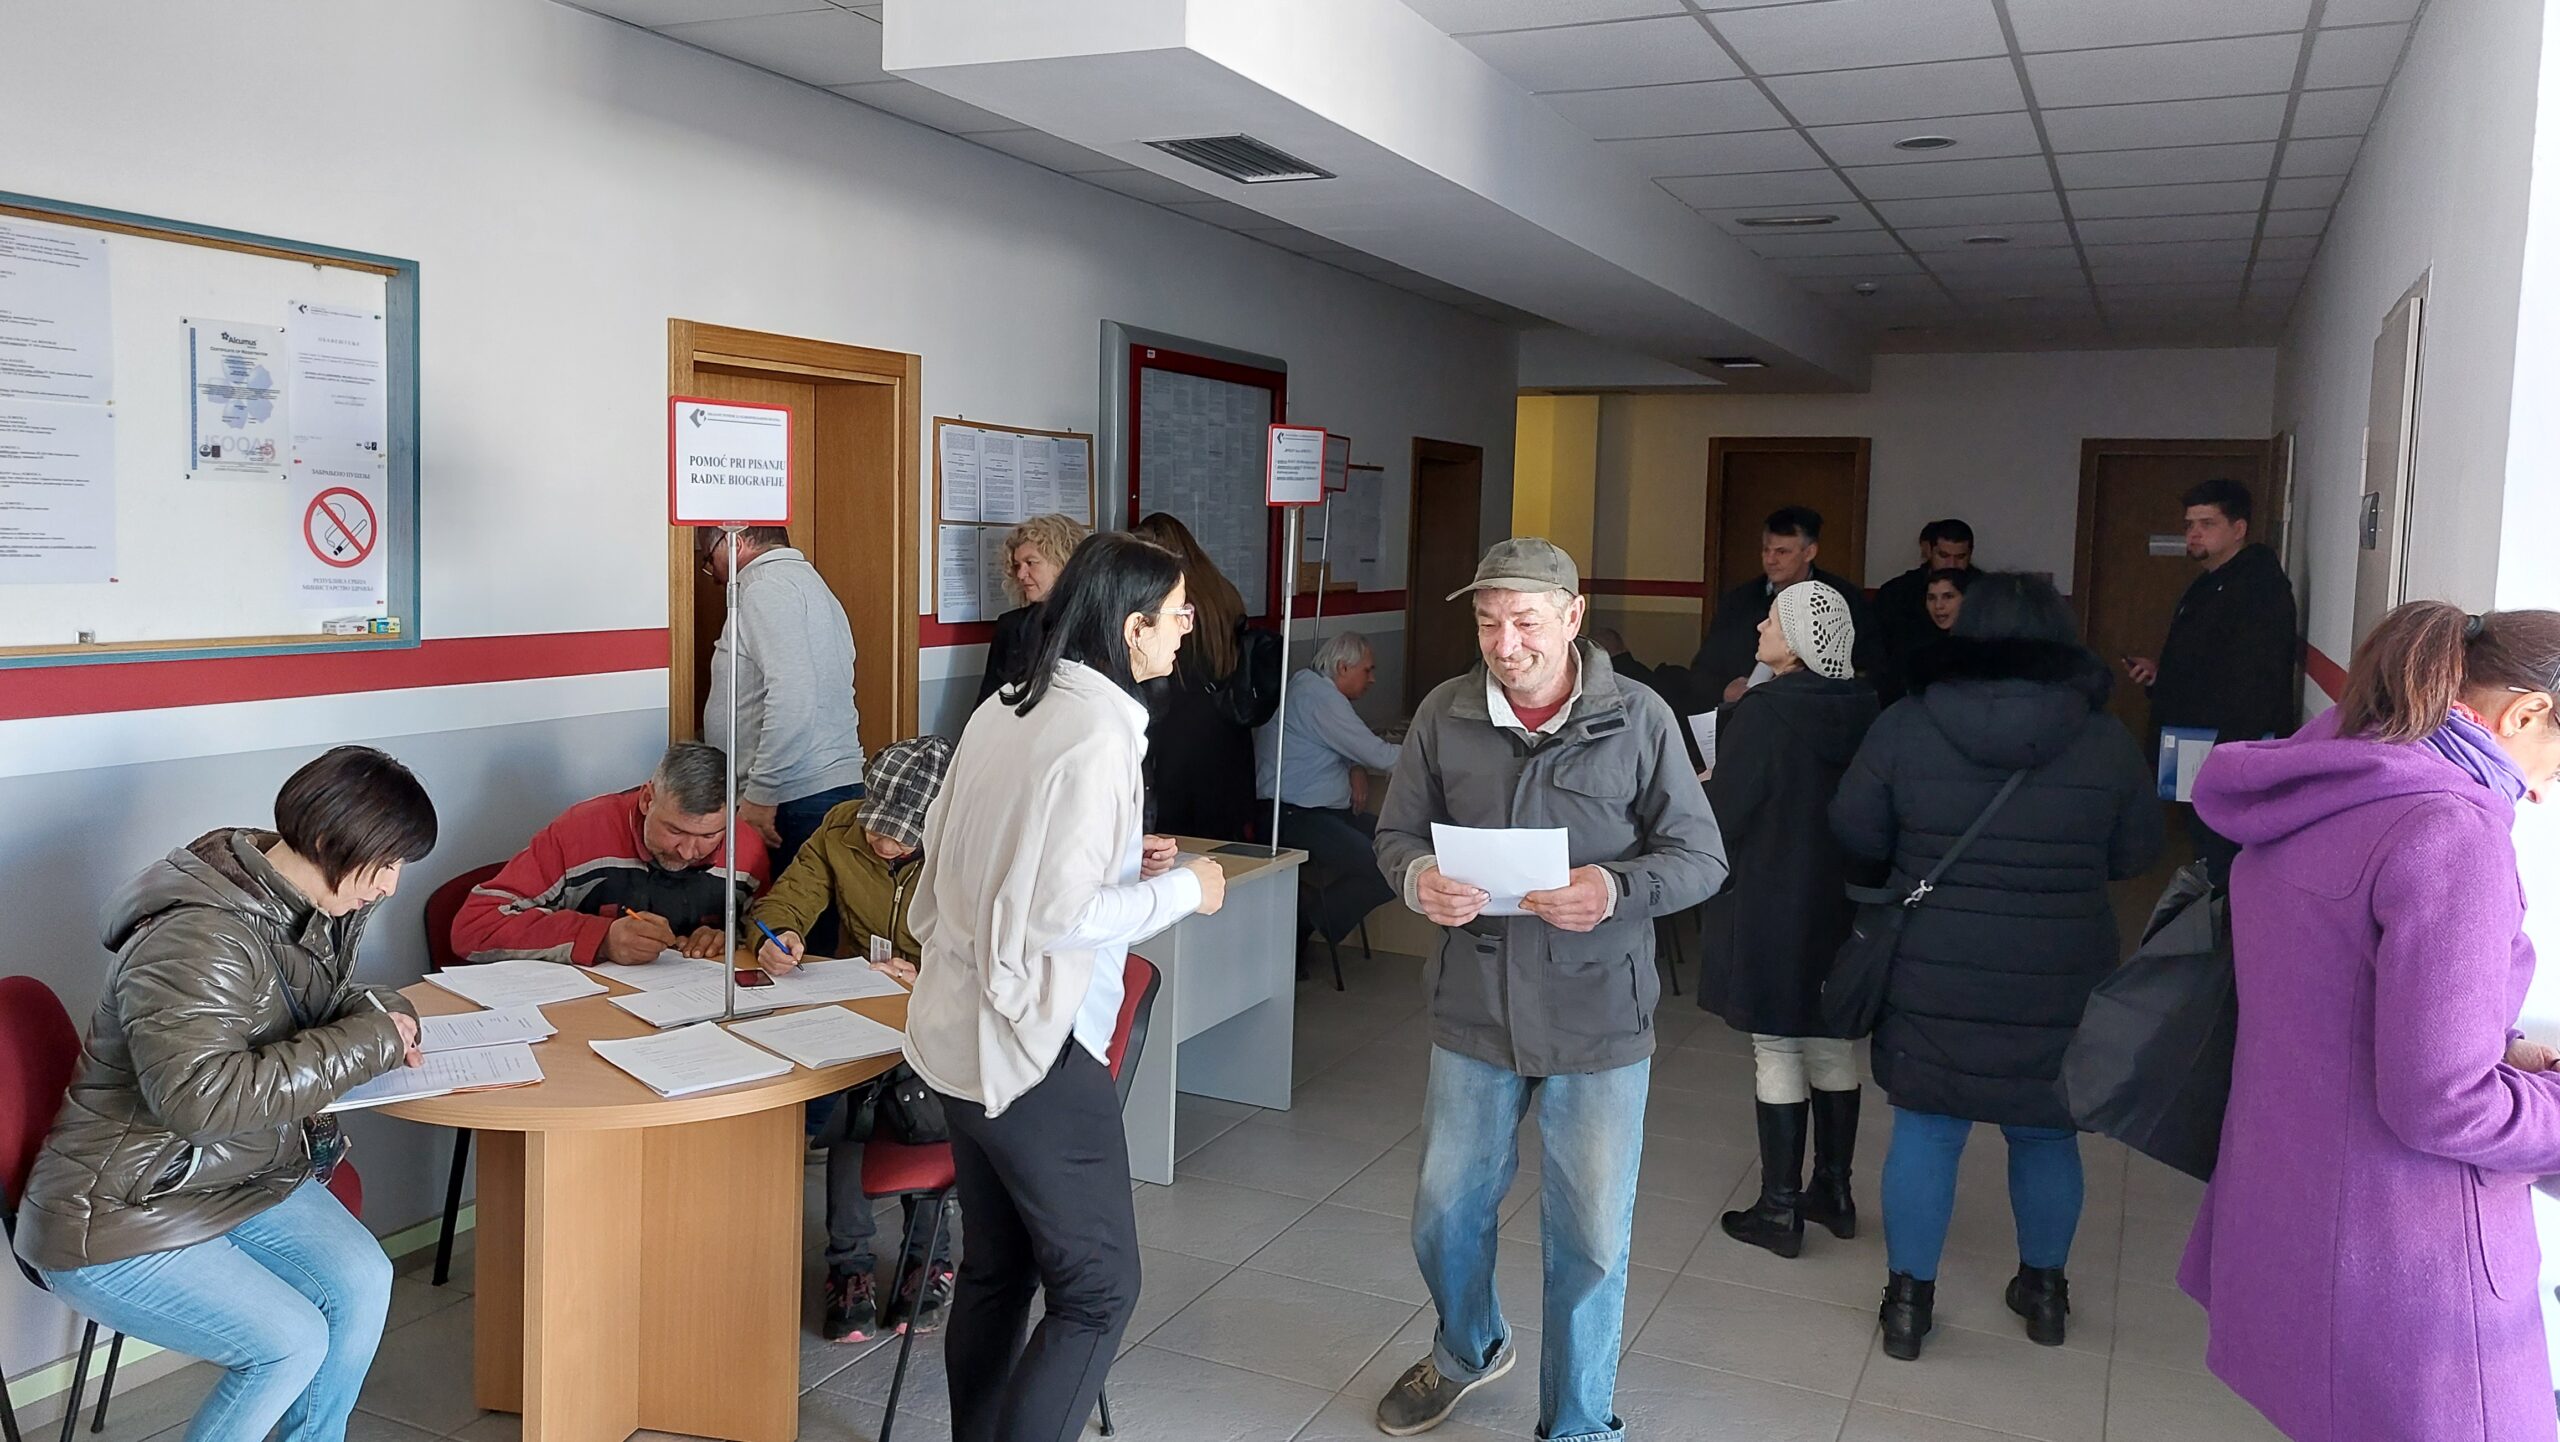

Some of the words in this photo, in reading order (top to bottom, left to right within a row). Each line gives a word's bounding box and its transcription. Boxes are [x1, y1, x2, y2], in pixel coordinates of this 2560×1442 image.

[229, 336, 257, 346] Alcumus
[689, 454, 728, 468] POMOĆ
[730, 458, 746, 468] PRI
[748, 459, 786, 471] PISANJU
[691, 473, 726, 485] RADNE
[729, 475, 785, 487] BIOGRAFIJE
